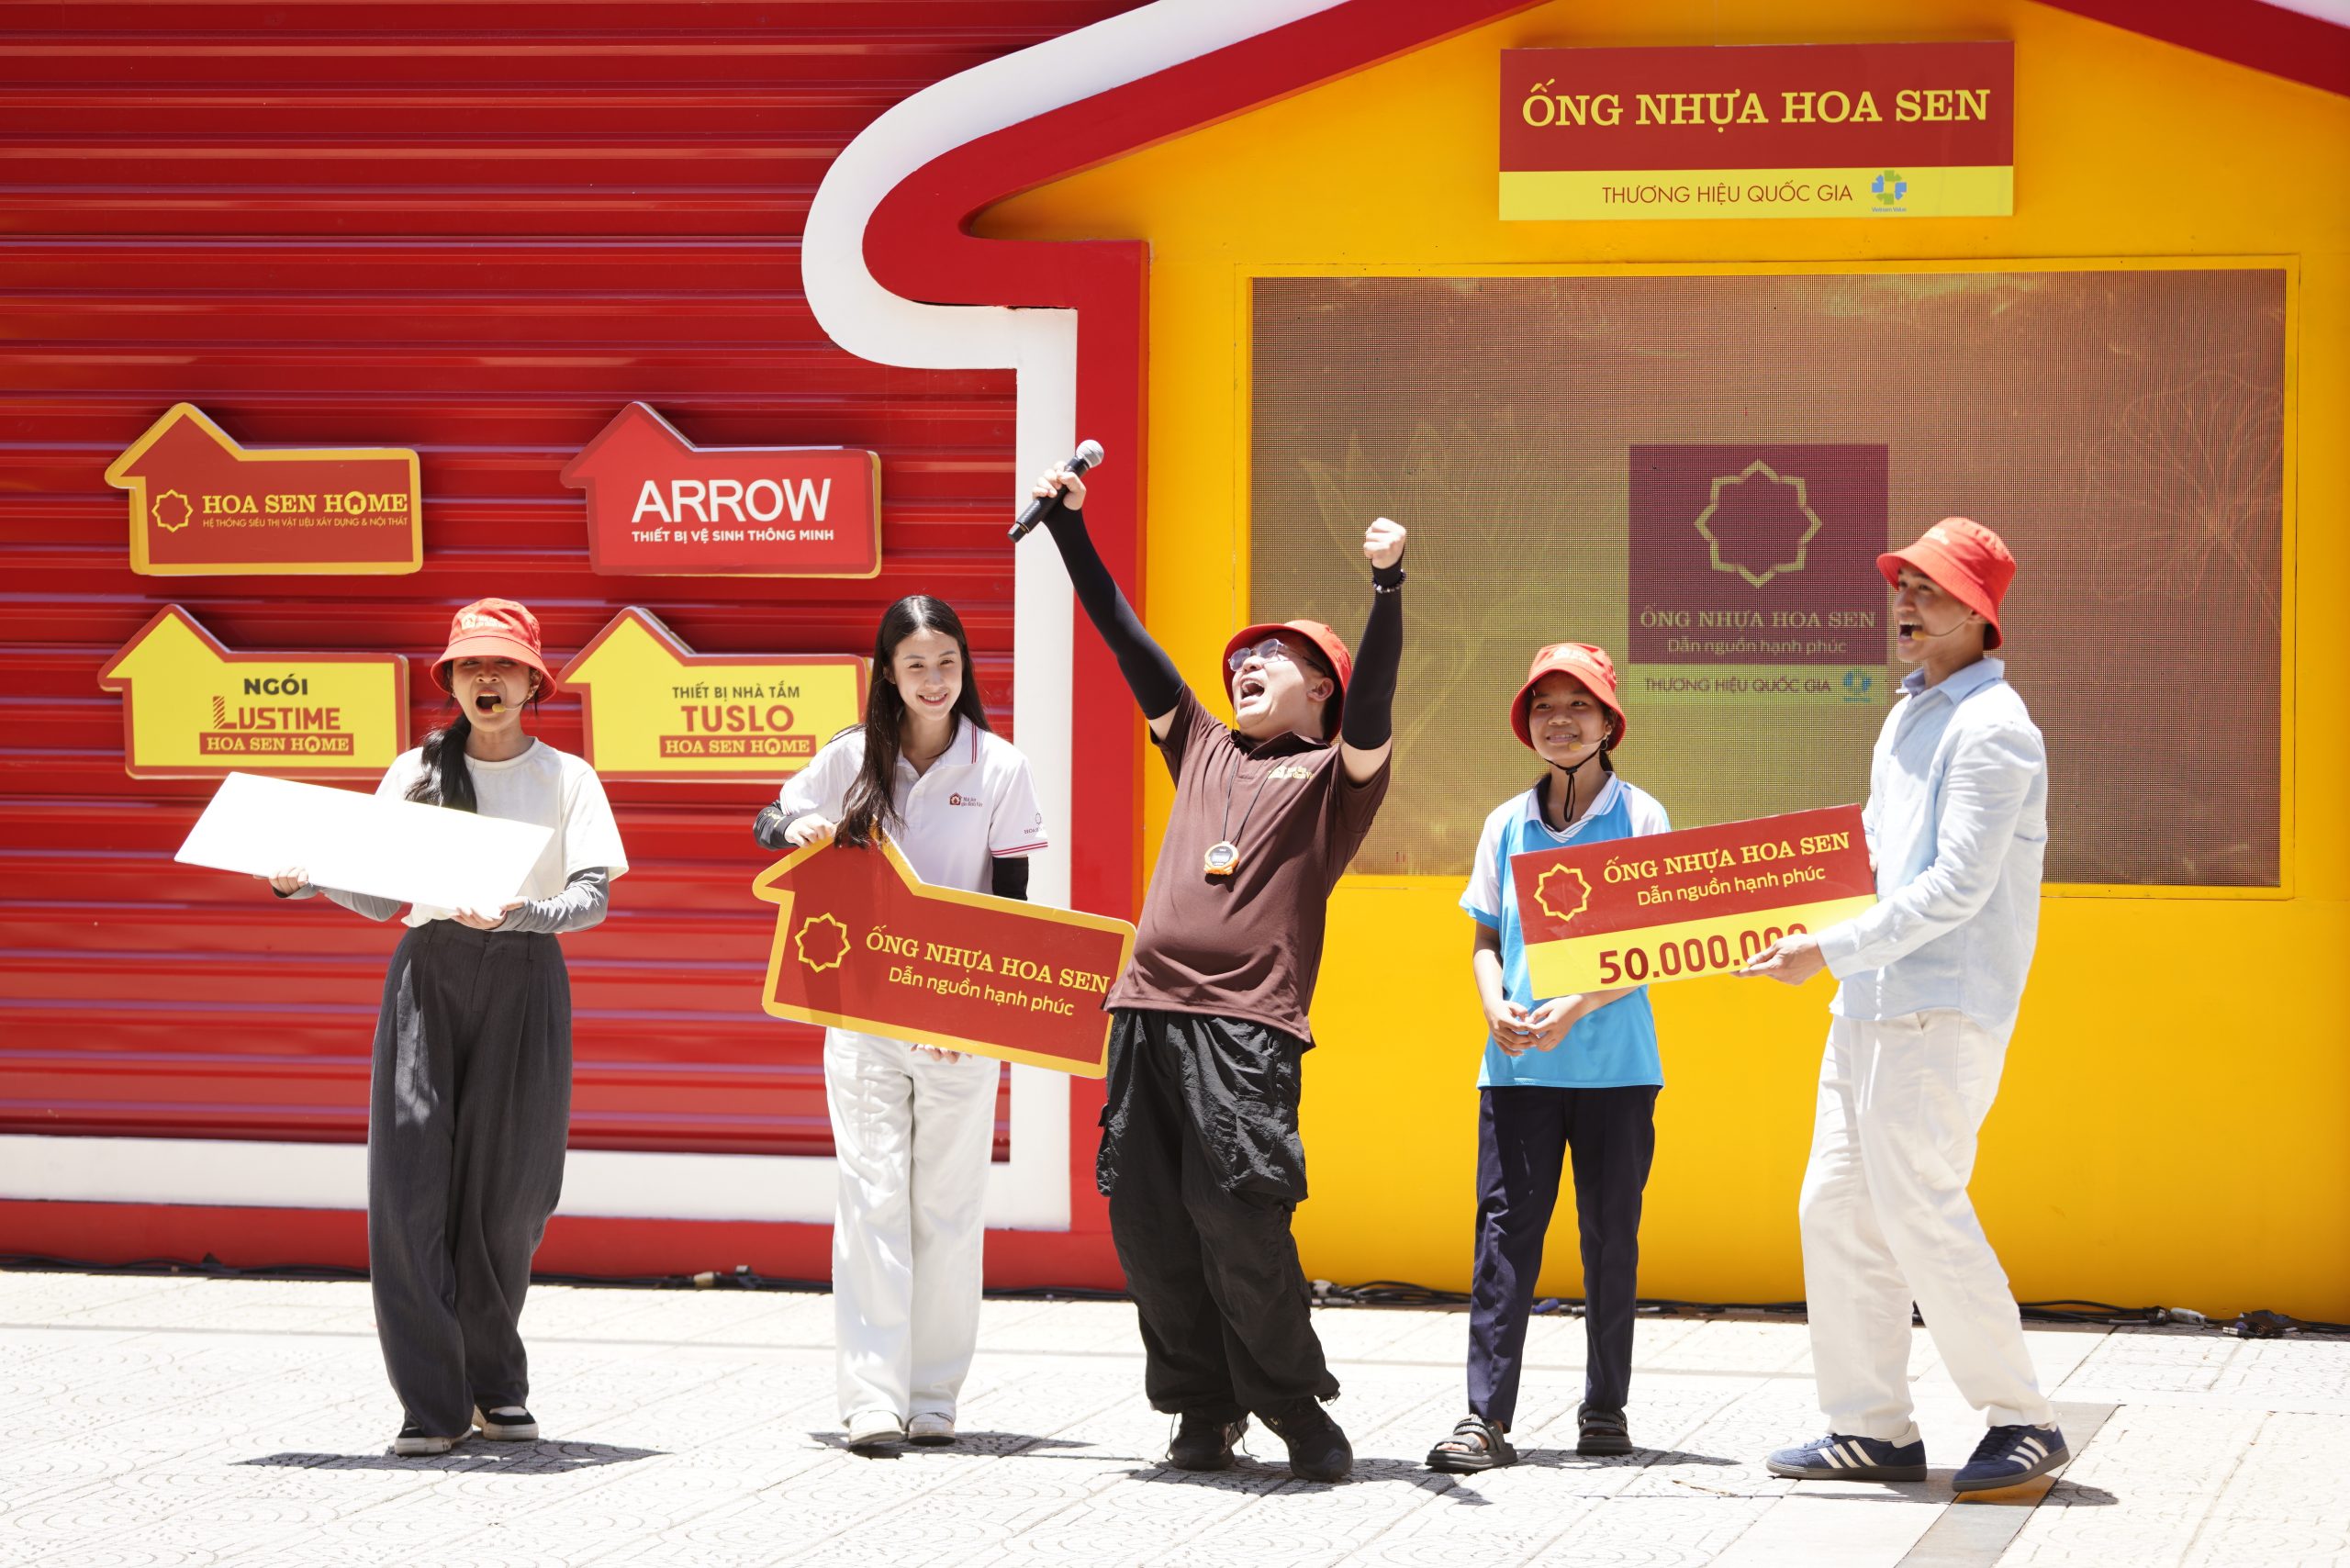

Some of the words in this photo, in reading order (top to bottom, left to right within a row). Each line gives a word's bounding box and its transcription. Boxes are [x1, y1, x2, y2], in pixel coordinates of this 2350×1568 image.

[1522, 78, 1624, 127] ỐNG
[1636, 88, 1769, 133] NHỰA
[1782, 90, 1883, 123] HOA
[1895, 89, 1990, 121] SEN
[1602, 184, 1690, 204] THƯƠNG
[1696, 182, 1740, 206] HIỆU
[1747, 179, 1810, 203] QUỐC
[1818, 184, 1852, 202] GIA
[202, 495, 259, 514] HOA
[265, 494, 317, 513] SEN
[323, 491, 408, 515] HOME
[632, 478, 831, 523] ARROW
[362, 518, 367, 526] &
[632, 527, 670, 542] THIẾT
[674, 531, 687, 543] BỊ
[691, 529, 709, 543] VỆ
[712, 531, 744, 542] SINH
[747, 528, 795, 541] THÔNG
[800, 530, 834, 541] MINH
[1640, 605, 1691, 628] ỐNG
[1699, 608, 1764, 630] NHỰA
[1774, 611, 1821, 628] HOA
[1829, 611, 1876, 628] SEN
[1669, 635, 1700, 652] Dẫn
[1761, 638, 1801, 655] hạnh
[1807, 637, 1847, 655] phúc
[244, 674, 308, 695] NGÓI
[672, 681, 709, 699] THIẾT
[714, 687, 727, 701] BỊ
[733, 682, 764, 699] NHÀ
[769, 681, 800, 699] TẮM
[1804, 679, 1830, 691] GIA
[681, 705, 794, 733] TUSLO
[207, 738, 246, 751] HOA
[250, 738, 285, 751] SEN
[291, 736, 349, 752] HOME
[666, 740, 705, 753] HOA
[709, 740, 745, 754] SEN
[750, 738, 810, 755] HOME
[1604, 856, 1659, 884] ỐNG
[1664, 849, 1736, 877] NHỰA
[1742, 841, 1796, 864] HOA
[1800, 832, 1850, 856] SEN
[1637, 883, 1673, 906] Dẫn
[1677, 876, 1732, 902] nguồn
[1735, 873, 1780, 895] hạnh
[1783, 866, 1826, 890] phúc
[866, 925, 920, 958] ỐNG
[923, 943, 994, 974] NHỰA
[1002, 957, 1054, 984] HOA
[1058, 969, 1111, 993] SEN
[889, 964, 923, 988] Dẫn
[926, 975, 980, 999] nguồn
[984, 984, 1027, 1008] hạnh
[1031, 995, 1075, 1016] phúc
